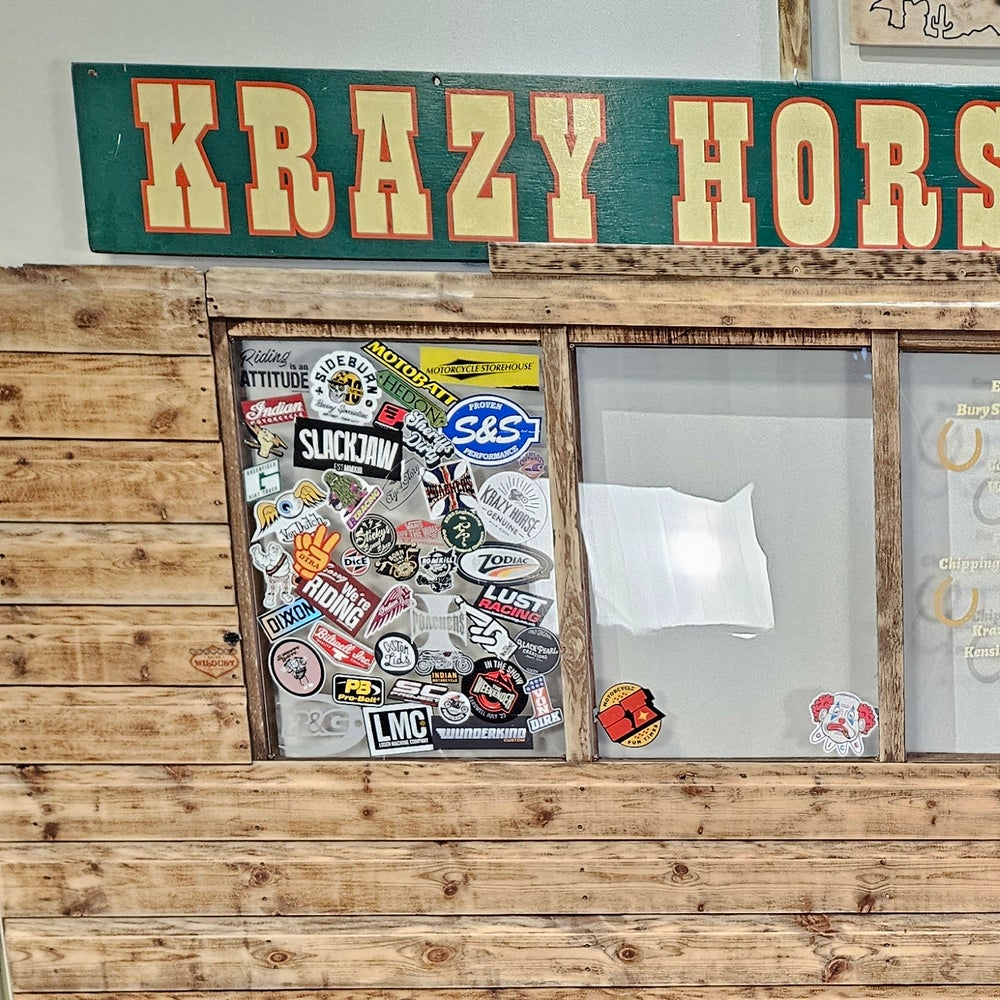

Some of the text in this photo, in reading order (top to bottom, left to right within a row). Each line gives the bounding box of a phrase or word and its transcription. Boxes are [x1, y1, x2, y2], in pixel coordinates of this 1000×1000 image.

[131, 77, 606, 243] KRAZY
[241, 348, 292, 367] Riding
[426, 362, 532, 375] MOTORCYCLE STOREHOUSE
[240, 370, 310, 389] ATTITUDE
[315, 355, 378, 395] SIDEBURN
[368, 340, 459, 407] MOTOBATT
[245, 400, 304, 424] Indian
[469, 400, 503, 412] PROVEN
[956, 403, 990, 419] Bury
[452, 415, 524, 445] S&S
[299, 428, 399, 472] SLACKJAW
[463, 444, 519, 461] PERFORMANCE
[480, 484, 511, 512] KRAZY
[510, 506, 541, 538] HORSE
[486, 510, 518, 535] GENUINE
[297, 512, 324, 538] Dutch
[477, 552, 530, 575] ZODIAC
[939, 557, 1000, 575] Chipping
[302, 576, 364, 632] RIDING
[342, 582, 372, 611] We're
[483, 585, 548, 612] LUST
[267, 597, 317, 635] DIXXON
[478, 598, 542, 624] RACING
[314, 626, 355, 655] Biltwell
[383, 639, 410, 654] CUSTOM
[517, 638, 540, 652] BLACK
[538, 643, 559, 656] PEARL
[431, 671, 458, 680] INDIAN
[484, 660, 495, 670] IN
[495, 660, 508, 672] THE
[506, 666, 524, 685] SHOW
[337, 693, 380, 705] Pro-Bolt
[345, 679, 372, 695] PB
[394, 679, 449, 696] SC
[473, 676, 516, 710] WEEKENDER
[602, 685, 635, 709] MOTORCYCLE
[532, 689, 550, 714] VON
[373, 709, 428, 743] LMC
[530, 711, 562, 732] DIRK
[436, 727, 527, 741] WUNDERKIND
[627, 723, 660, 746] FUN TIMES
